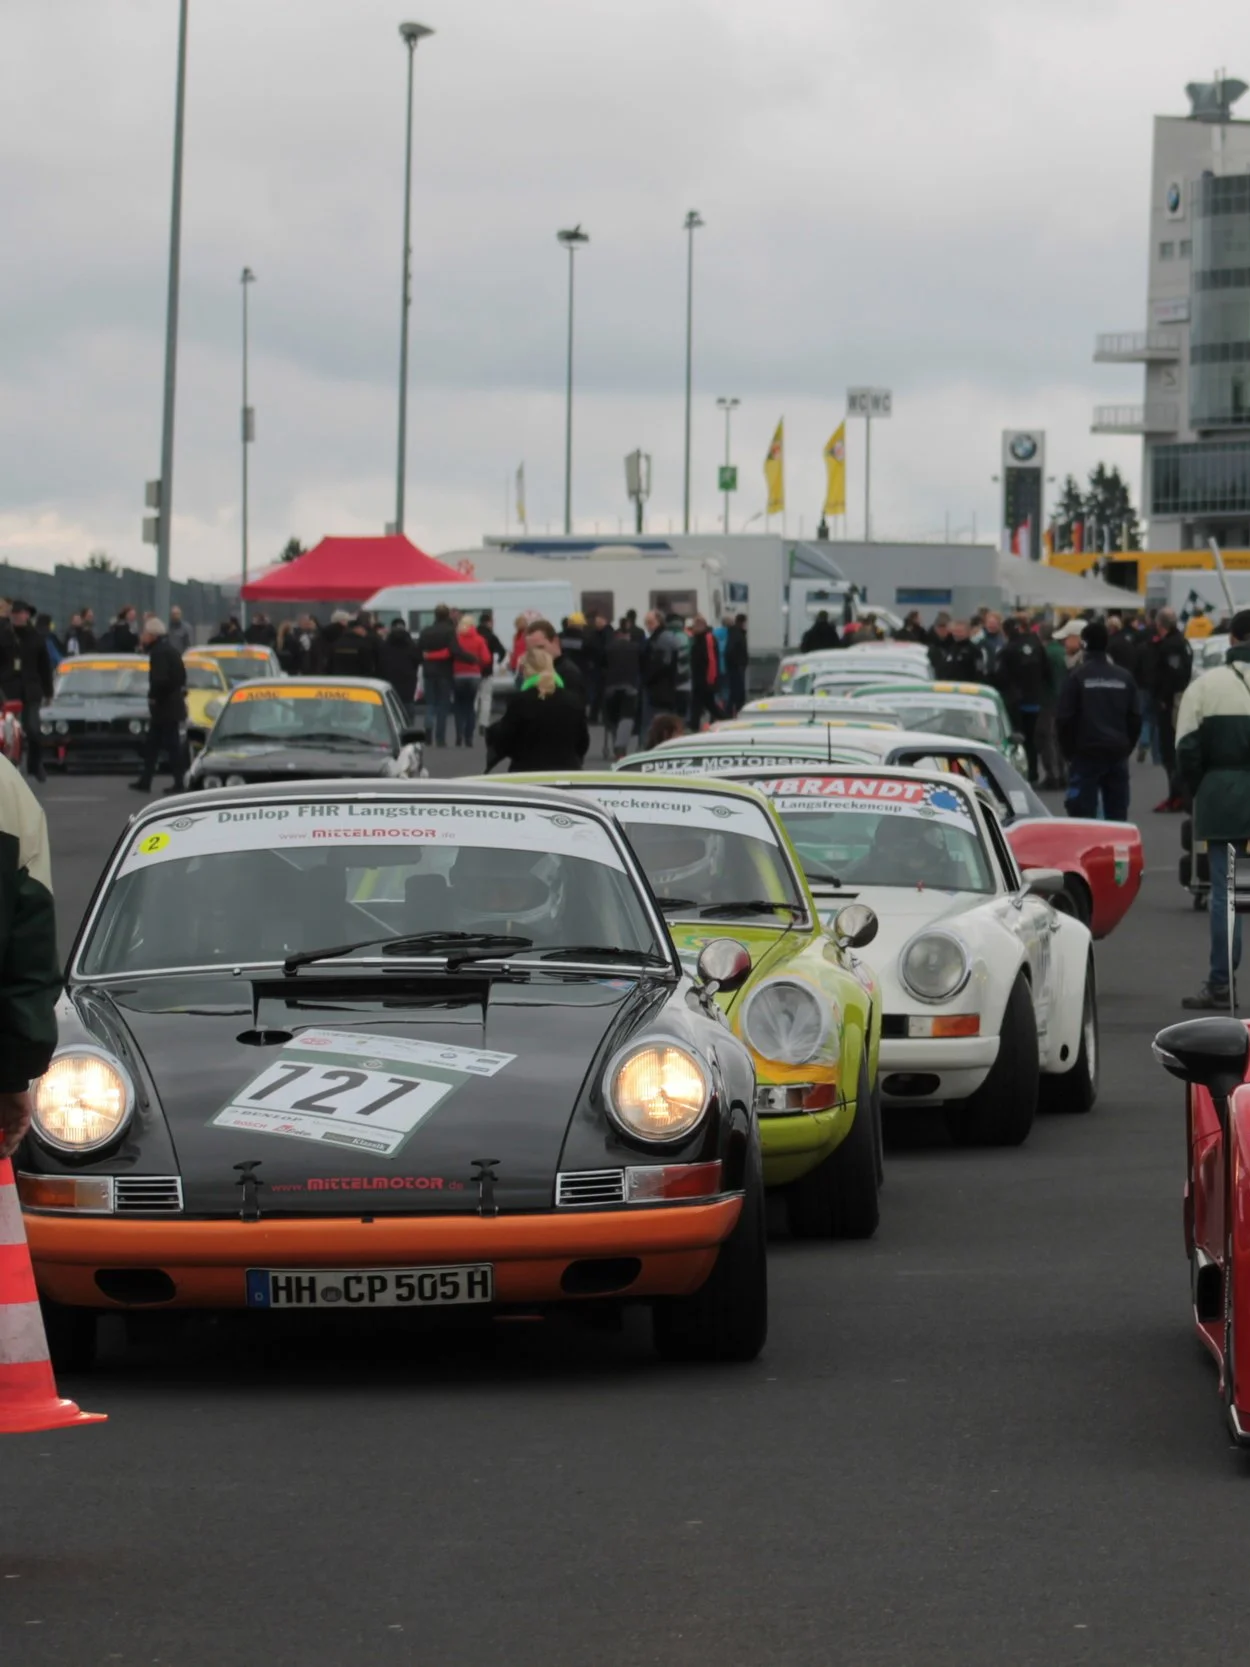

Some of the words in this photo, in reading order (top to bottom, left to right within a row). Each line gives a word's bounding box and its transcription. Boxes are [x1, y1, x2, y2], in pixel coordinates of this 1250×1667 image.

[849, 394, 868, 411] WC
[871, 394, 890, 411] WC
[218, 807, 289, 824] Dunlop
[298, 805, 340, 817] FHR
[348, 804, 526, 823] Langstreckencup
[147, 836, 160, 851] 2
[248, 1063, 421, 1116] 727
[271, 1275, 316, 1304] HH
[343, 1274, 388, 1304] CP
[395, 1271, 460, 1302] 505
[467, 1270, 489, 1299] H
